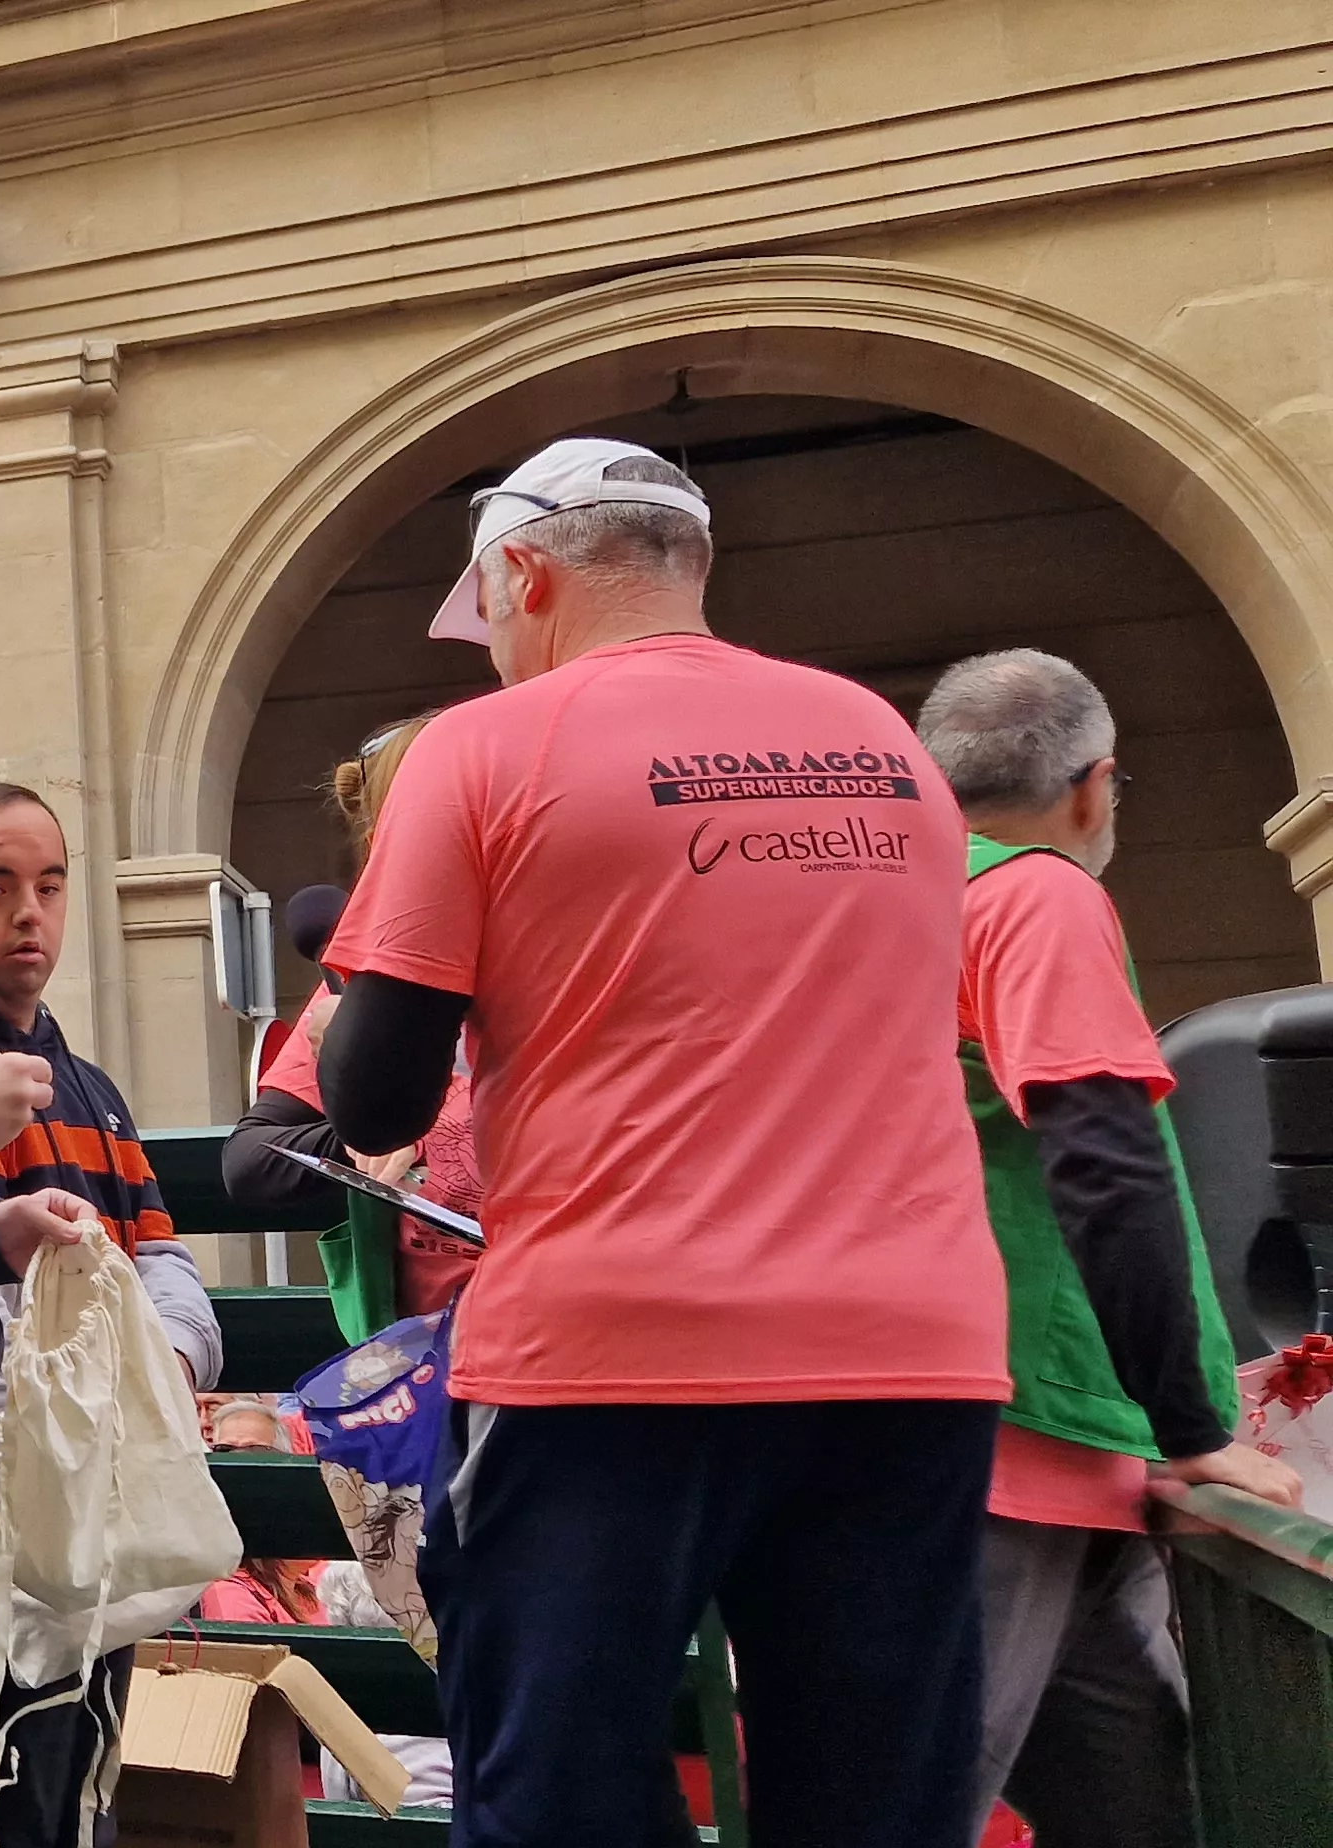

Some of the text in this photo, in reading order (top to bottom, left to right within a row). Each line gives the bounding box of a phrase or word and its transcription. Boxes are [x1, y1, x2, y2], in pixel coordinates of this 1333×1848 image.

[647, 745, 914, 781] ALTOARAGÓN
[678, 778, 895, 801] SUPERMERCADOS
[739, 817, 910, 862] castellar
